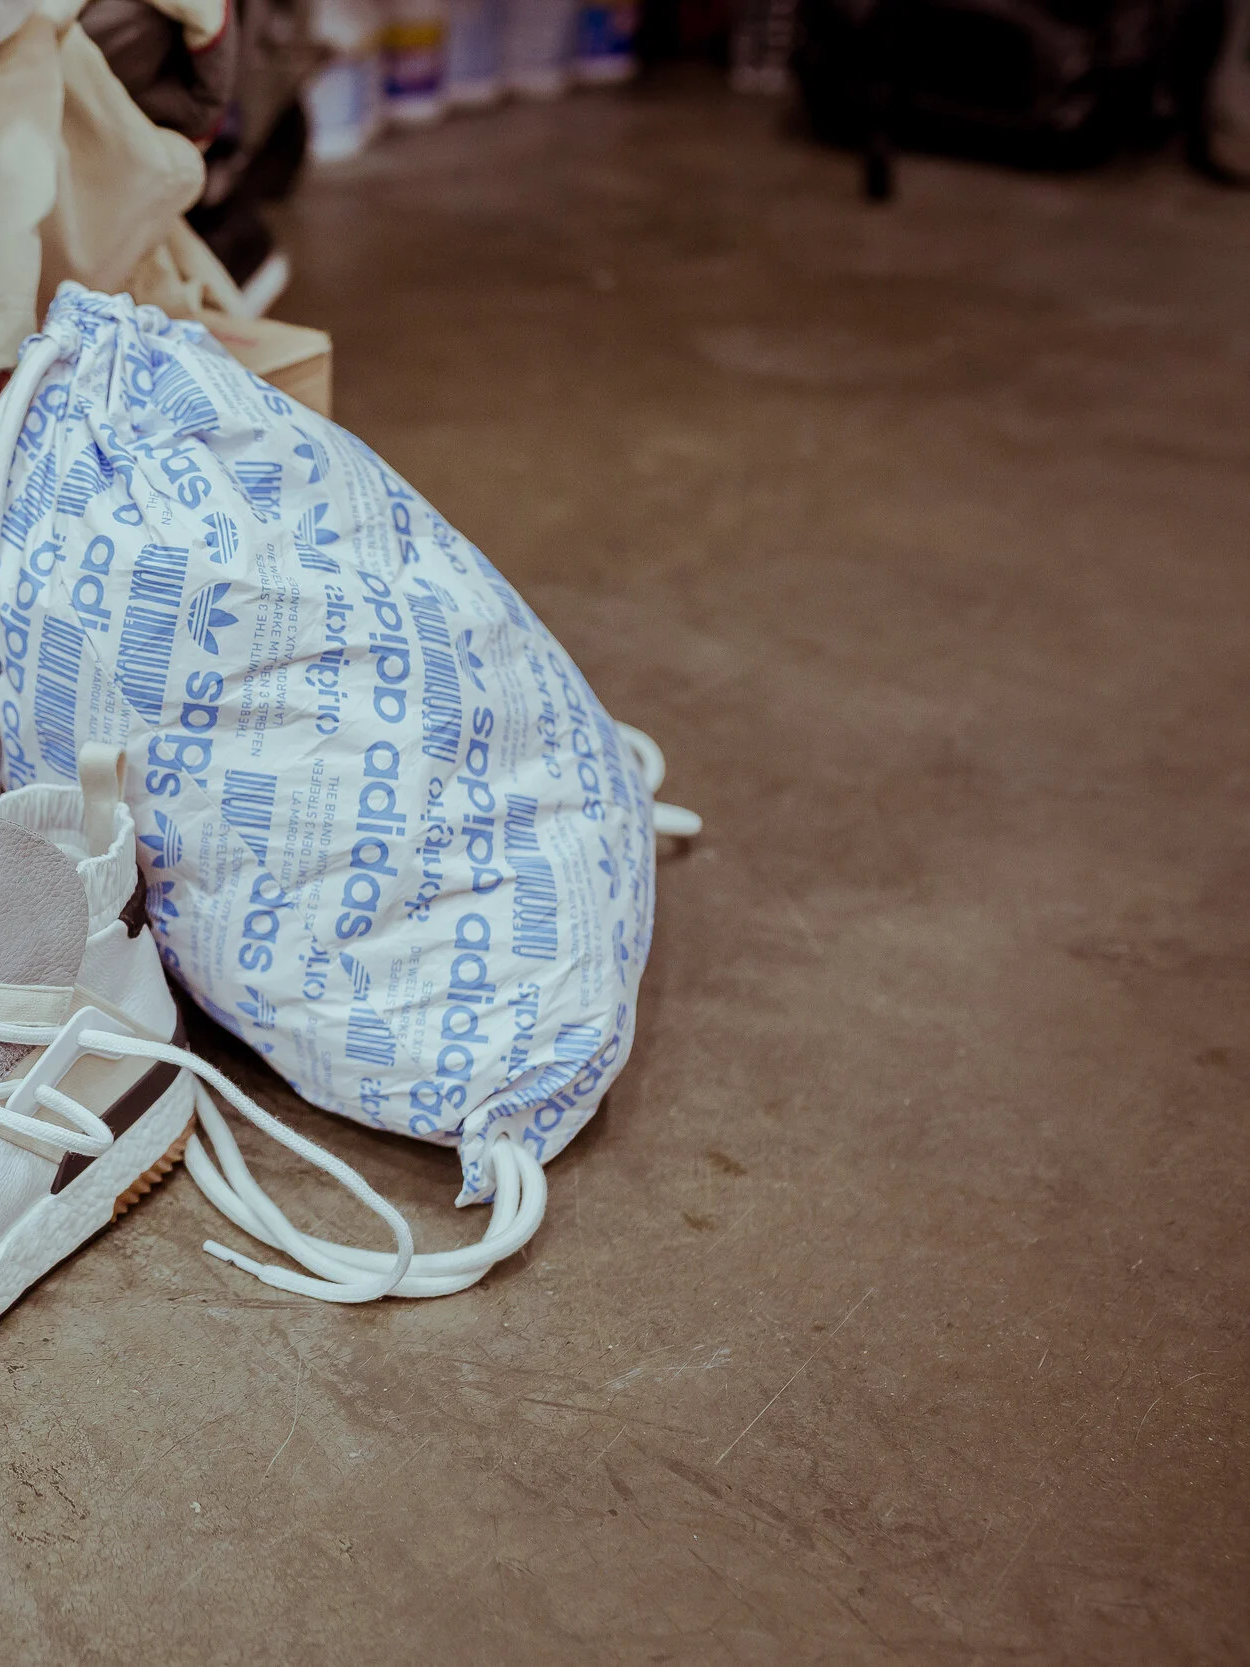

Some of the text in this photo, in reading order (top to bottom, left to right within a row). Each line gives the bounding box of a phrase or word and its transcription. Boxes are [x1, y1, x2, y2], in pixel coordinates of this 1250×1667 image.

[256, 554, 271, 600] STRIPES
[286, 576, 300, 622] BANDES
[270, 566, 286, 637] WELTMARKE
[254, 609, 268, 639] THE
[248, 643, 262, 673] WITH
[268, 640, 279, 663] MIT
[283, 635, 296, 660] AUX
[241, 674, 254, 716] BRAND
[236, 716, 249, 738] THE
[251, 702, 269, 756] STREIFEN
[274, 711, 284, 725] LA
[306, 758, 325, 819] STREIFEN
[328, 775, 340, 799] THE
[455, 705, 505, 896] adidas
[283, 790, 304, 857] LA MARQUE
[301, 829, 315, 855] DEN
[320, 802, 337, 846] BRAND
[334, 739, 408, 940] adidas
[434, 912, 497, 1110] adidas
